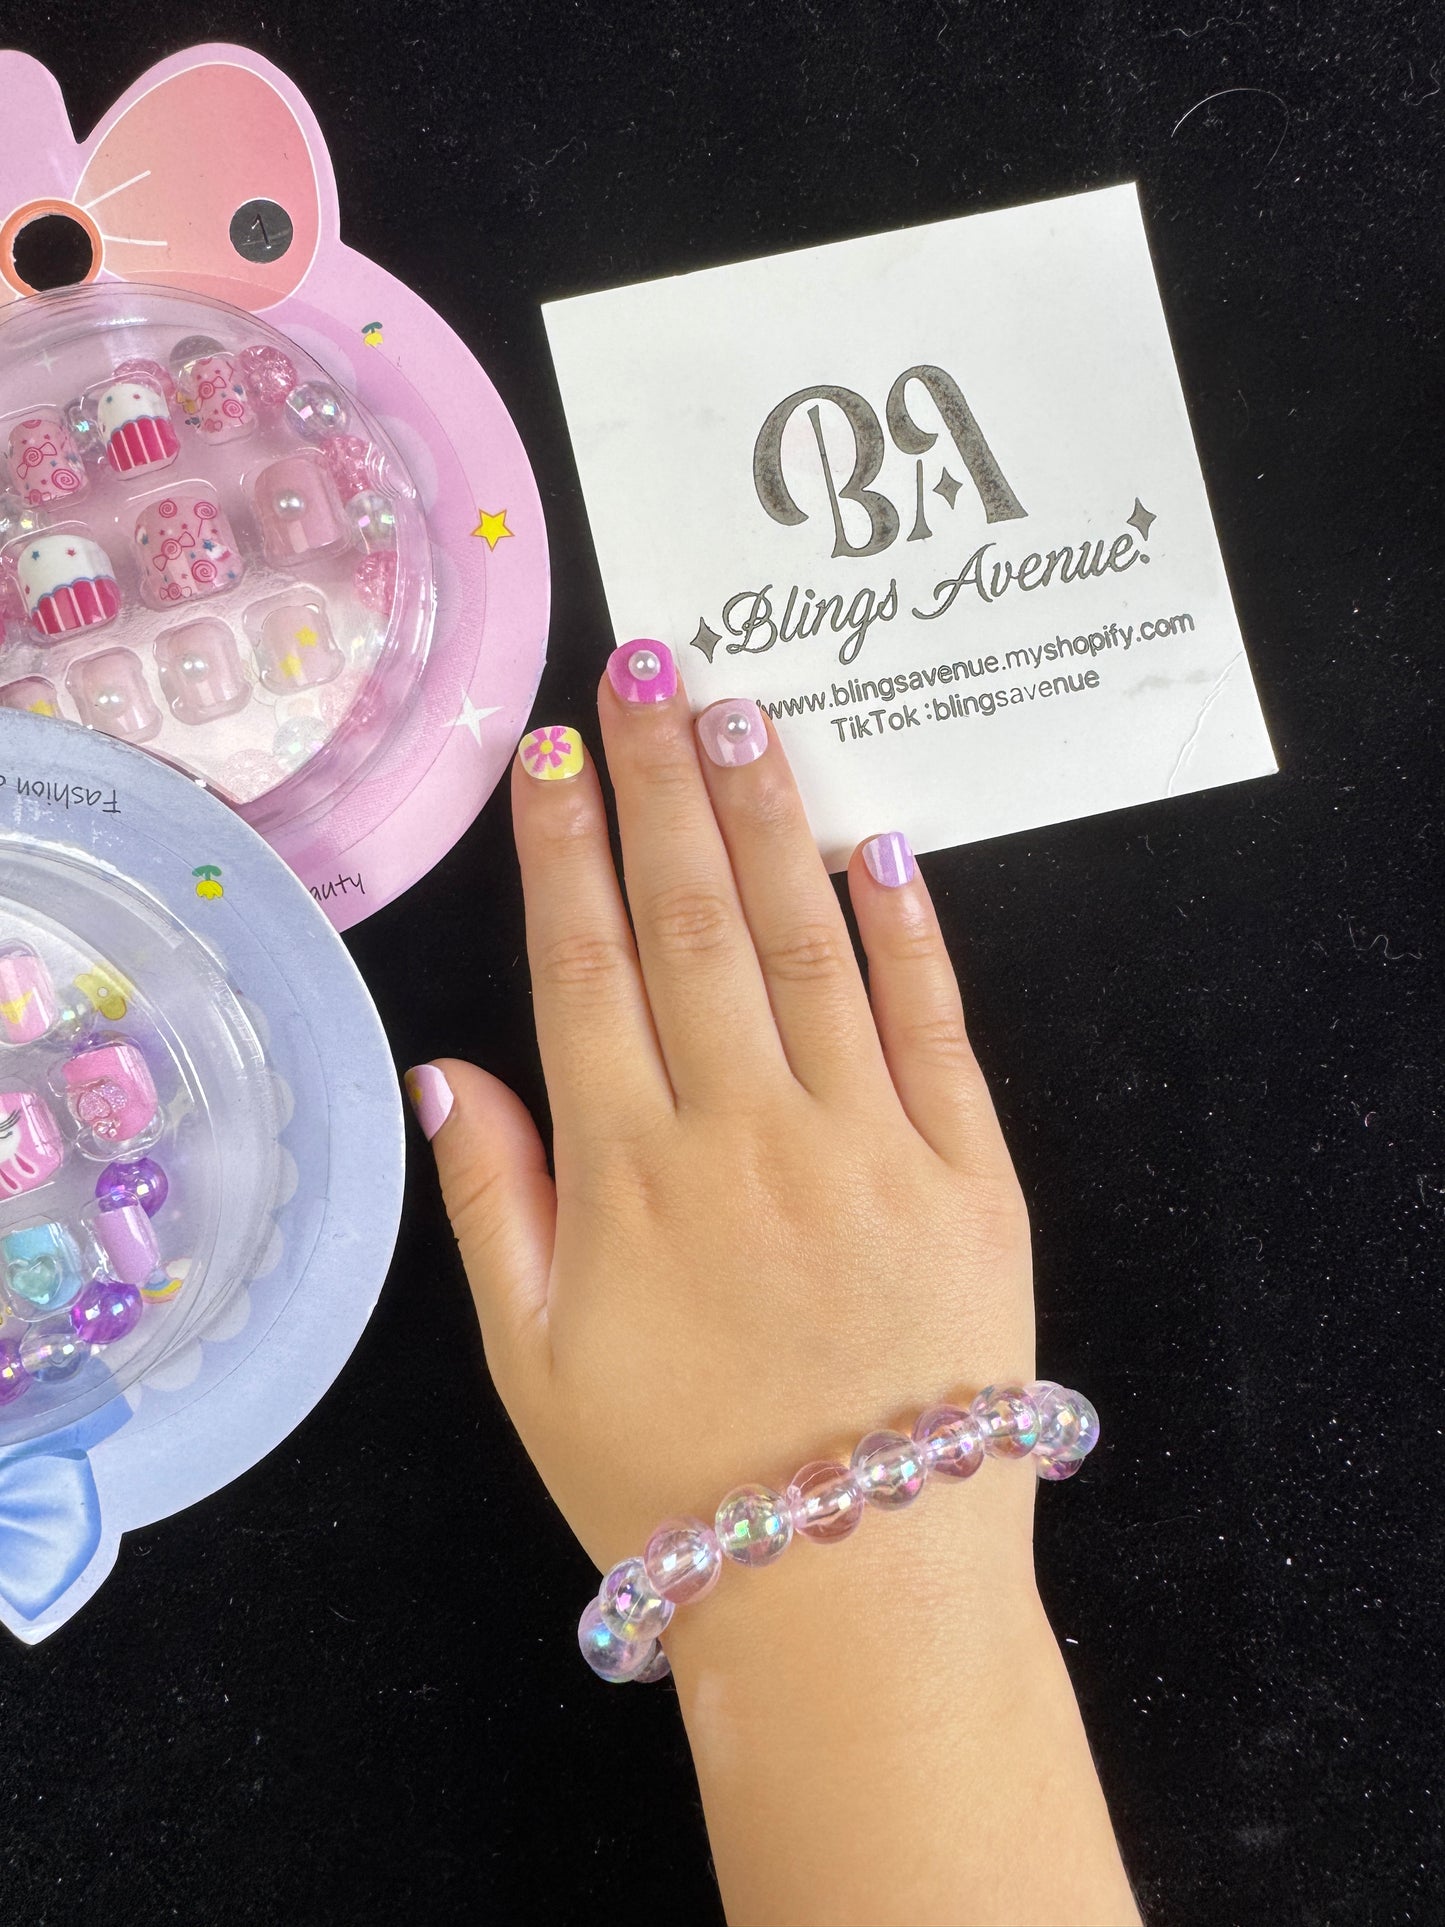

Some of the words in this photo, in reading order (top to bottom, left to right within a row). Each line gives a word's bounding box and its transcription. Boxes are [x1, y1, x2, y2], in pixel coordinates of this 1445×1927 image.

[753, 365, 1029, 558] BA
[722, 578, 898, 666] Blings
[830, 705, 921, 743] TikTok
[17, 777, 121, 813] Fashion
[309, 872, 366, 901] auty
